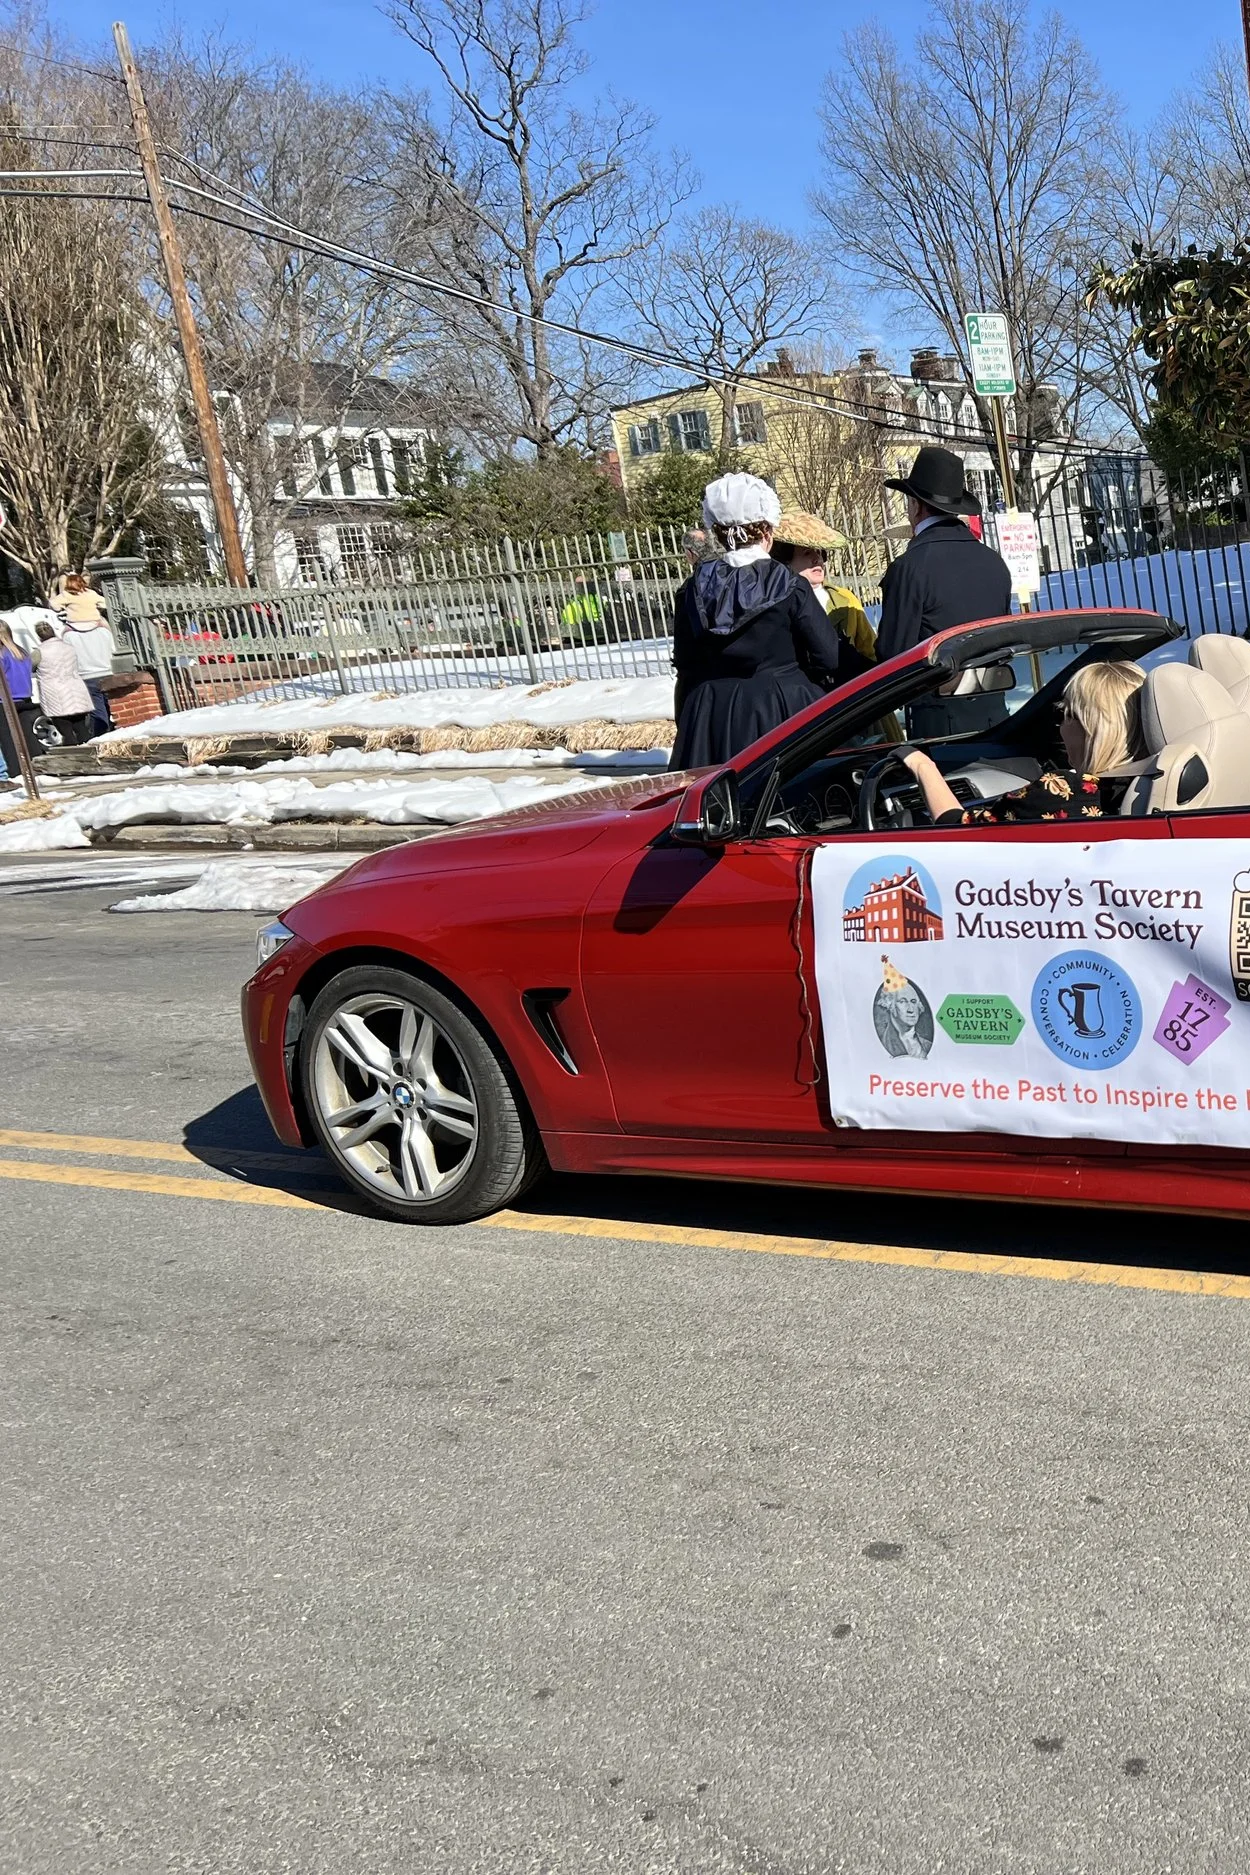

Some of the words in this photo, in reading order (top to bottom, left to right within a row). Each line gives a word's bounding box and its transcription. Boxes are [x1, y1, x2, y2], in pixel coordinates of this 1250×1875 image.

[969, 321, 979, 340] 2
[980, 321, 998, 331] HOUR
[981, 331, 1005, 340] PARKING
[1001, 524, 1032, 532] EMERGENCY
[1013, 533, 1024, 541] NO
[1003, 542, 1035, 552] PARKING
[955, 877, 1084, 913] Gadsby's
[1090, 879, 1203, 909] Tavern
[955, 912, 1088, 939] Museum
[1094, 912, 1203, 950] Society
[1052, 960, 1116, 980] COMMUNITY
[1194, 987, 1217, 1010] EST.
[946, 1007, 1013, 1020] GADSBY'S
[1101, 989, 1133, 1058] CELEBRATION
[1176, 1001, 1211, 1032] 17
[953, 1020, 1009, 1031] TAVERN
[1039, 988, 1089, 1060] CONVERSATION
[1163, 1019, 1198, 1051] 85
[869, 1074, 965, 1098] Preserve
[971, 1078, 1010, 1100] the
[1017, 1079, 1068, 1102] Past
[1073, 1083, 1098, 1104] to
[1106, 1083, 1188, 1112] Inspire
[1195, 1088, 1237, 1110] the
